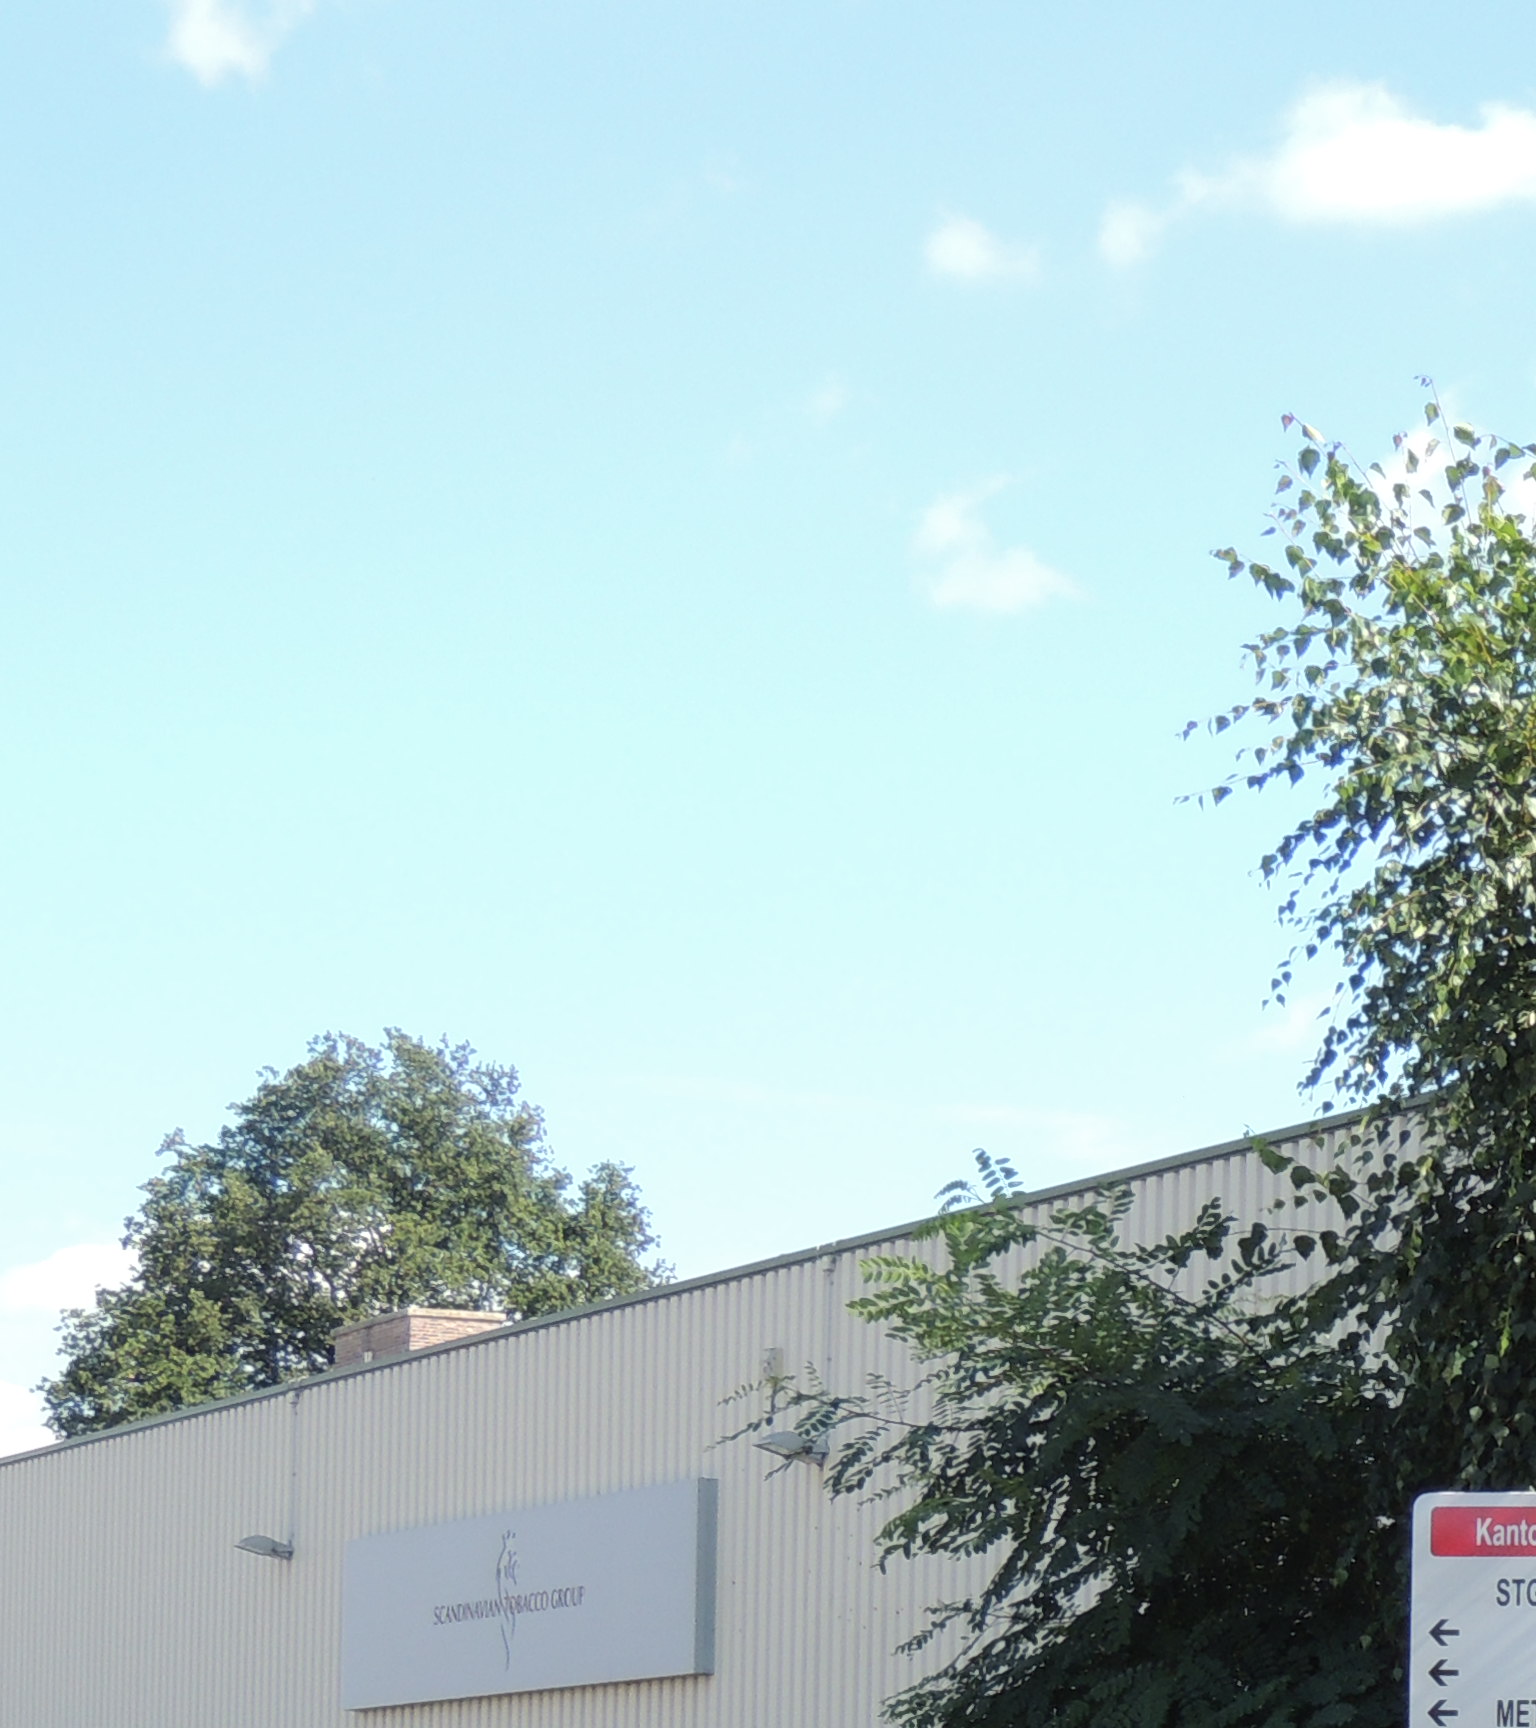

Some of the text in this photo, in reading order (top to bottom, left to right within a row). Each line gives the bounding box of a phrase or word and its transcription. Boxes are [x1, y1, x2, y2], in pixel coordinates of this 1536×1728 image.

[433, 1585, 585, 1625] SCANDINAVIAN TOBACCO GROUP
